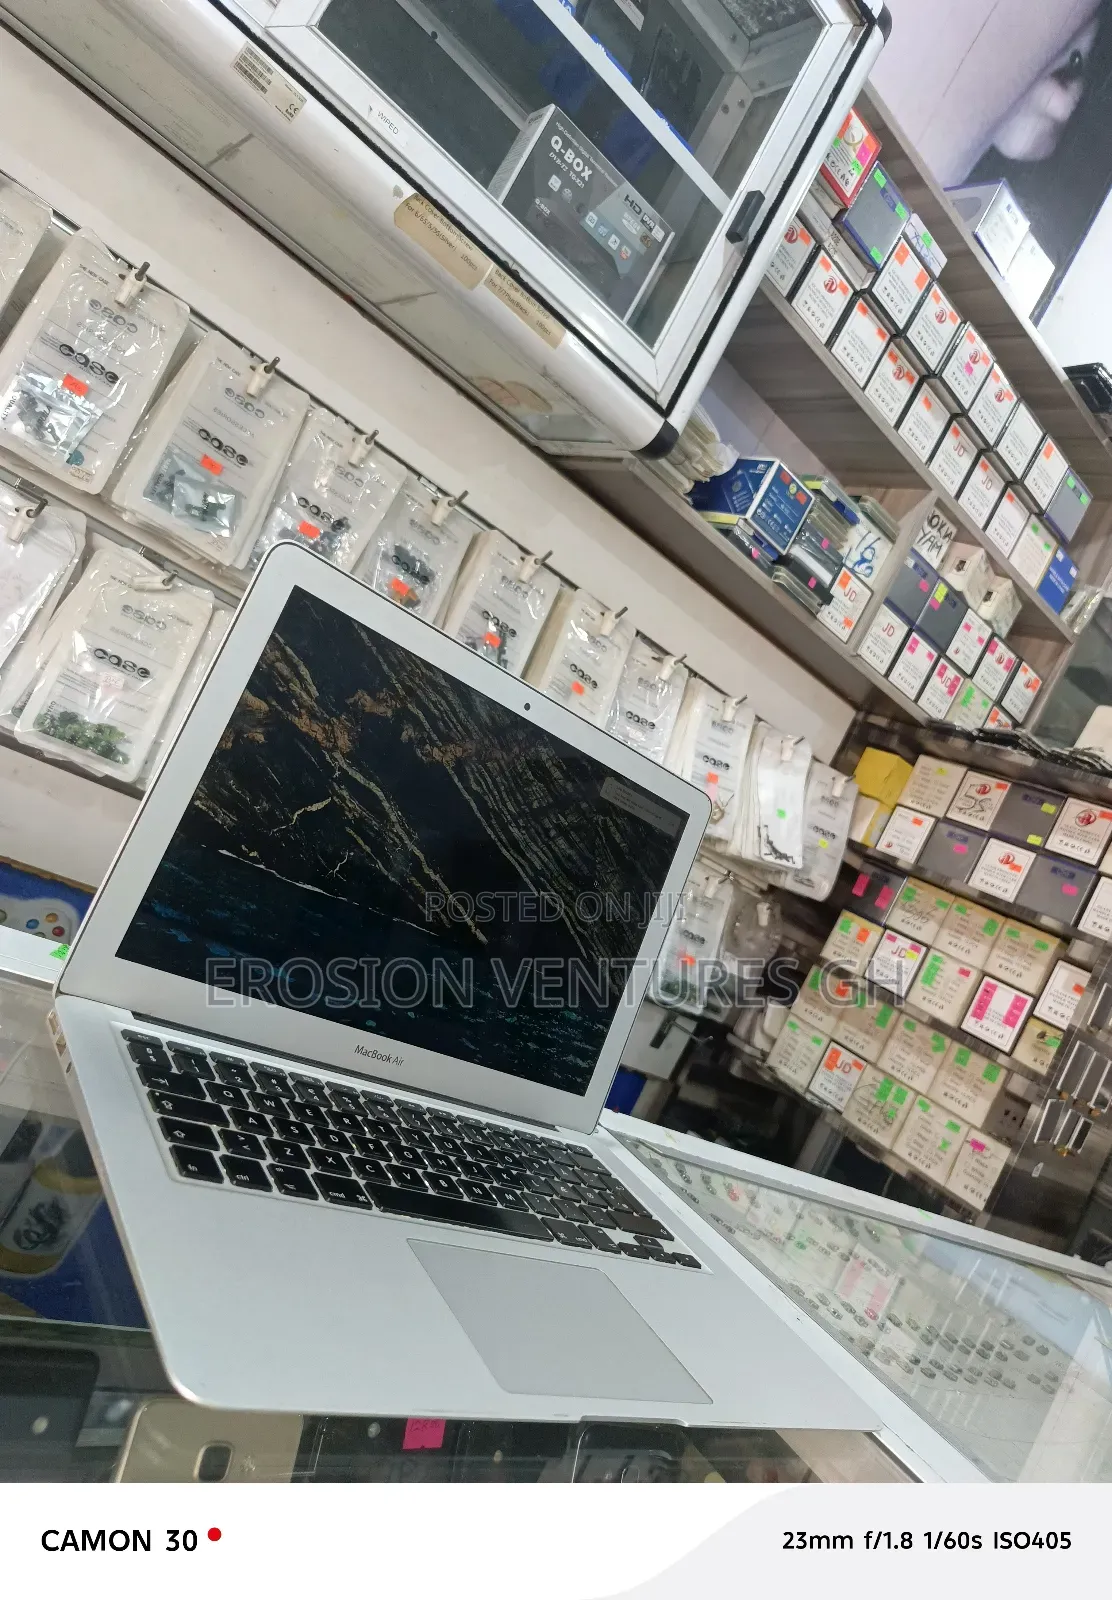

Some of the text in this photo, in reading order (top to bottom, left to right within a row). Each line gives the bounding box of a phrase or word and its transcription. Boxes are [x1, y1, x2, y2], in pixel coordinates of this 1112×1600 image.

[377, 111, 399, 135] WIPED
[550, 135, 592, 182] Q-BOX
[405, 202, 415, 214] For
[535, 198, 550, 215] Q-BOX
[624, 194, 655, 230] HD DVR
[59, 343, 120, 384] case
[198, 428, 249, 466] case
[953, 441, 965, 457] JD
[981, 476, 993, 491] JD
[843, 588, 857, 603] JD
[482, 610, 517, 638] case
[881, 622, 895, 638] JD
[93, 648, 151, 679] case
[570, 663, 598, 689] case
[626, 710, 656, 730] case
[703, 754, 730, 771] case
[354, 1044, 404, 1066] MacBook Air
[835, 1060, 851, 1074] JD
[223, 1090, 235, 1099] Q
[263, 1099, 276, 1108] W
[305, 1109, 314, 1117] E
[248, 1117, 258, 1125] A
[343, 1117, 352, 1125] R
[290, 1126, 299, 1134] S
[379, 1125, 387, 1133] T
[330, 1134, 339, 1143] D
[412, 1133, 421, 1141] Y
[368, 1142, 376, 1150] F
[284, 1148, 294, 1156] Z
[404, 1151, 413, 1159] G
[325, 1156, 336, 1165] X
[438, 1158, 447, 1166] H
[504, 1156, 513, 1164] O
[187, 1163, 198, 1172] fn
[365, 1165, 375, 1173] C
[235, 1174, 250, 1182] ctrl
[402, 1172, 412, 1180] V
[440, 1179, 449, 1187] B
[329, 1191, 346, 1199] cmd
[472, 1187, 483, 1195] N
[505, 1193, 516, 1201] M
